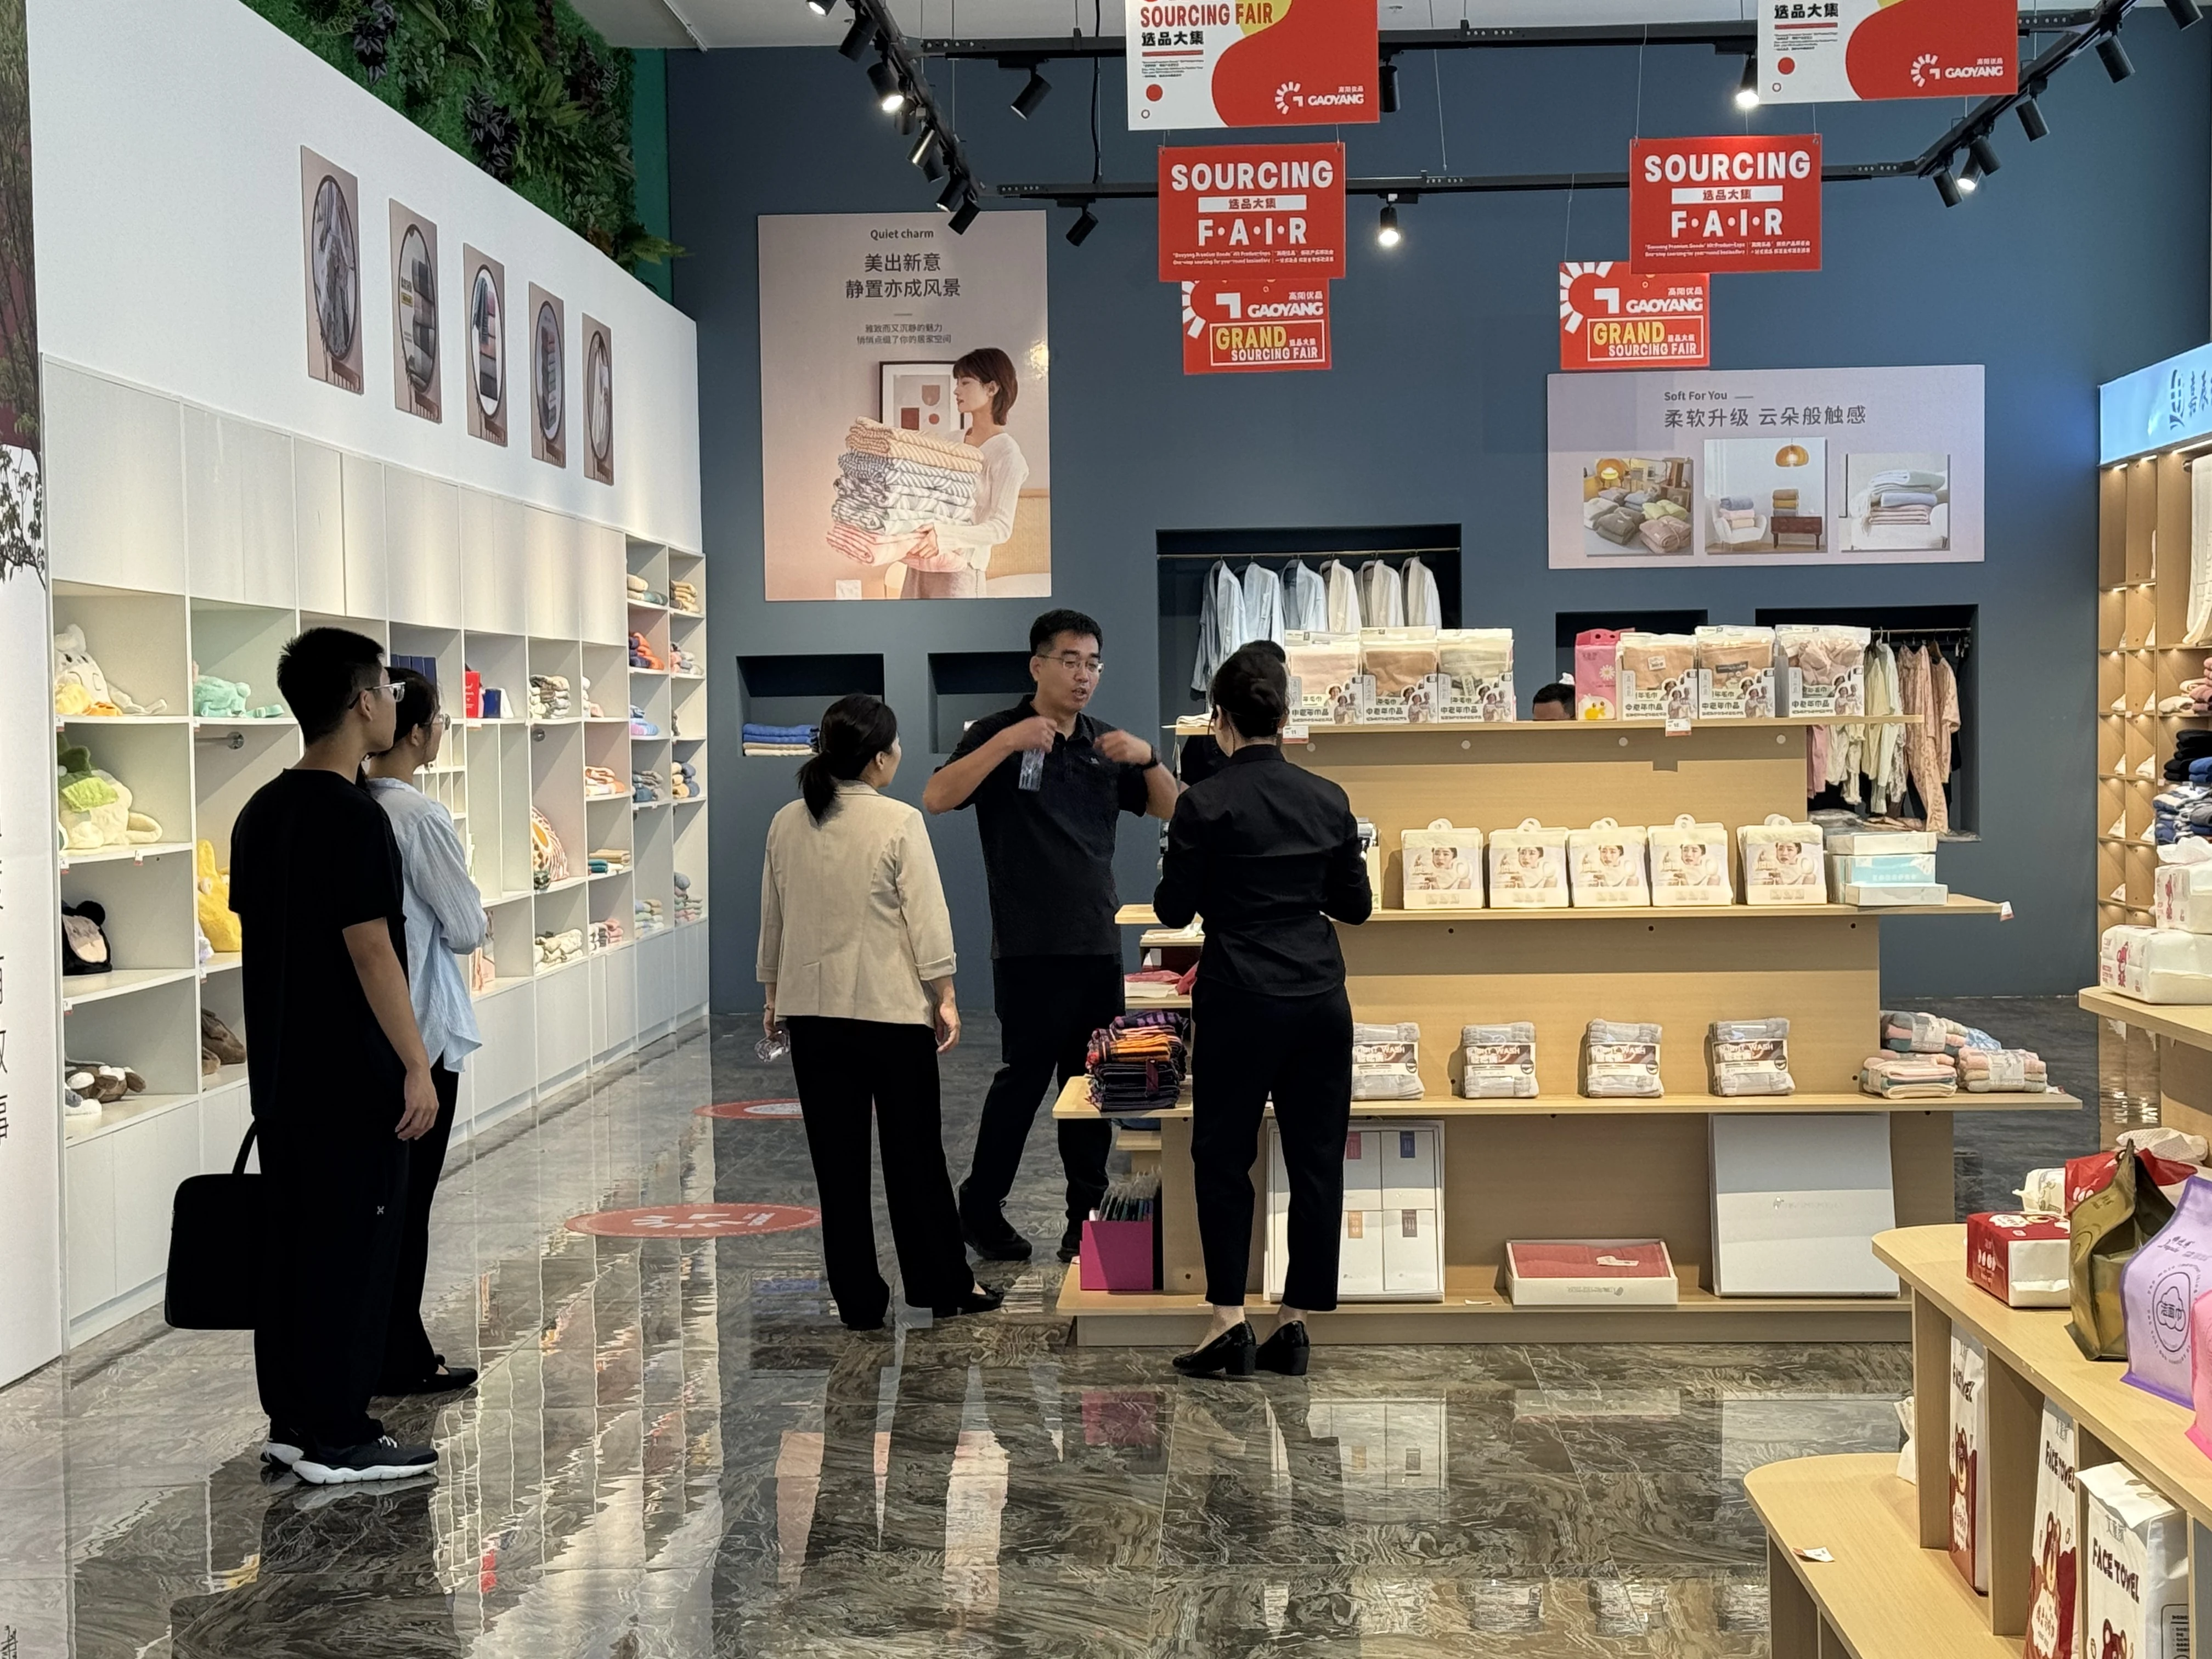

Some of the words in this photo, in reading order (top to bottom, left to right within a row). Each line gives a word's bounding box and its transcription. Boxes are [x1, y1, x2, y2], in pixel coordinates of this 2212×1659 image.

[1141, 4, 1230, 27] SOURCING
[1235, 2, 1273, 25] FAIR
[1774, 3, 1839, 19] 选品大集
[1142, 30, 1204, 47] 选品大集
[1945, 66, 2004, 79] GAOYANG
[1307, 93, 1364, 106] GAOYANG
[1645, 150, 1810, 183] SOURCING
[1171, 160, 1334, 191] SOURCING
[1702, 189, 1752, 201] 选品大集
[1228, 198, 1277, 210] 选品大集
[870, 229, 899, 241] Quiet
[901, 228, 934, 239] charm
[864, 253, 941, 273] 美出新意
[845, 278, 961, 299] 静置亦成风景
[1247, 302, 1324, 318] GAOYANG
[1626, 297, 1703, 313] GAOYANG
[1216, 326, 1287, 350] GRAND
[1593, 321, 1665, 345] GRAND
[1231, 347, 1290, 361] SOURCING
[1293, 346, 1318, 359] FAIR
[1609, 343, 1668, 357] SOURCING
[1672, 342, 1697, 355] FAIR
[1664, 391, 1685, 401] Soft
[1689, 392, 1706, 400] For
[1708, 391, 1728, 400] You
[1664, 408, 1748, 428] 柔软升级
[1758, 405, 1866, 426] 云朵般触感
[2093, 1537, 2113, 1580] FACE
[2114, 1560, 2140, 1605] TOWEL
